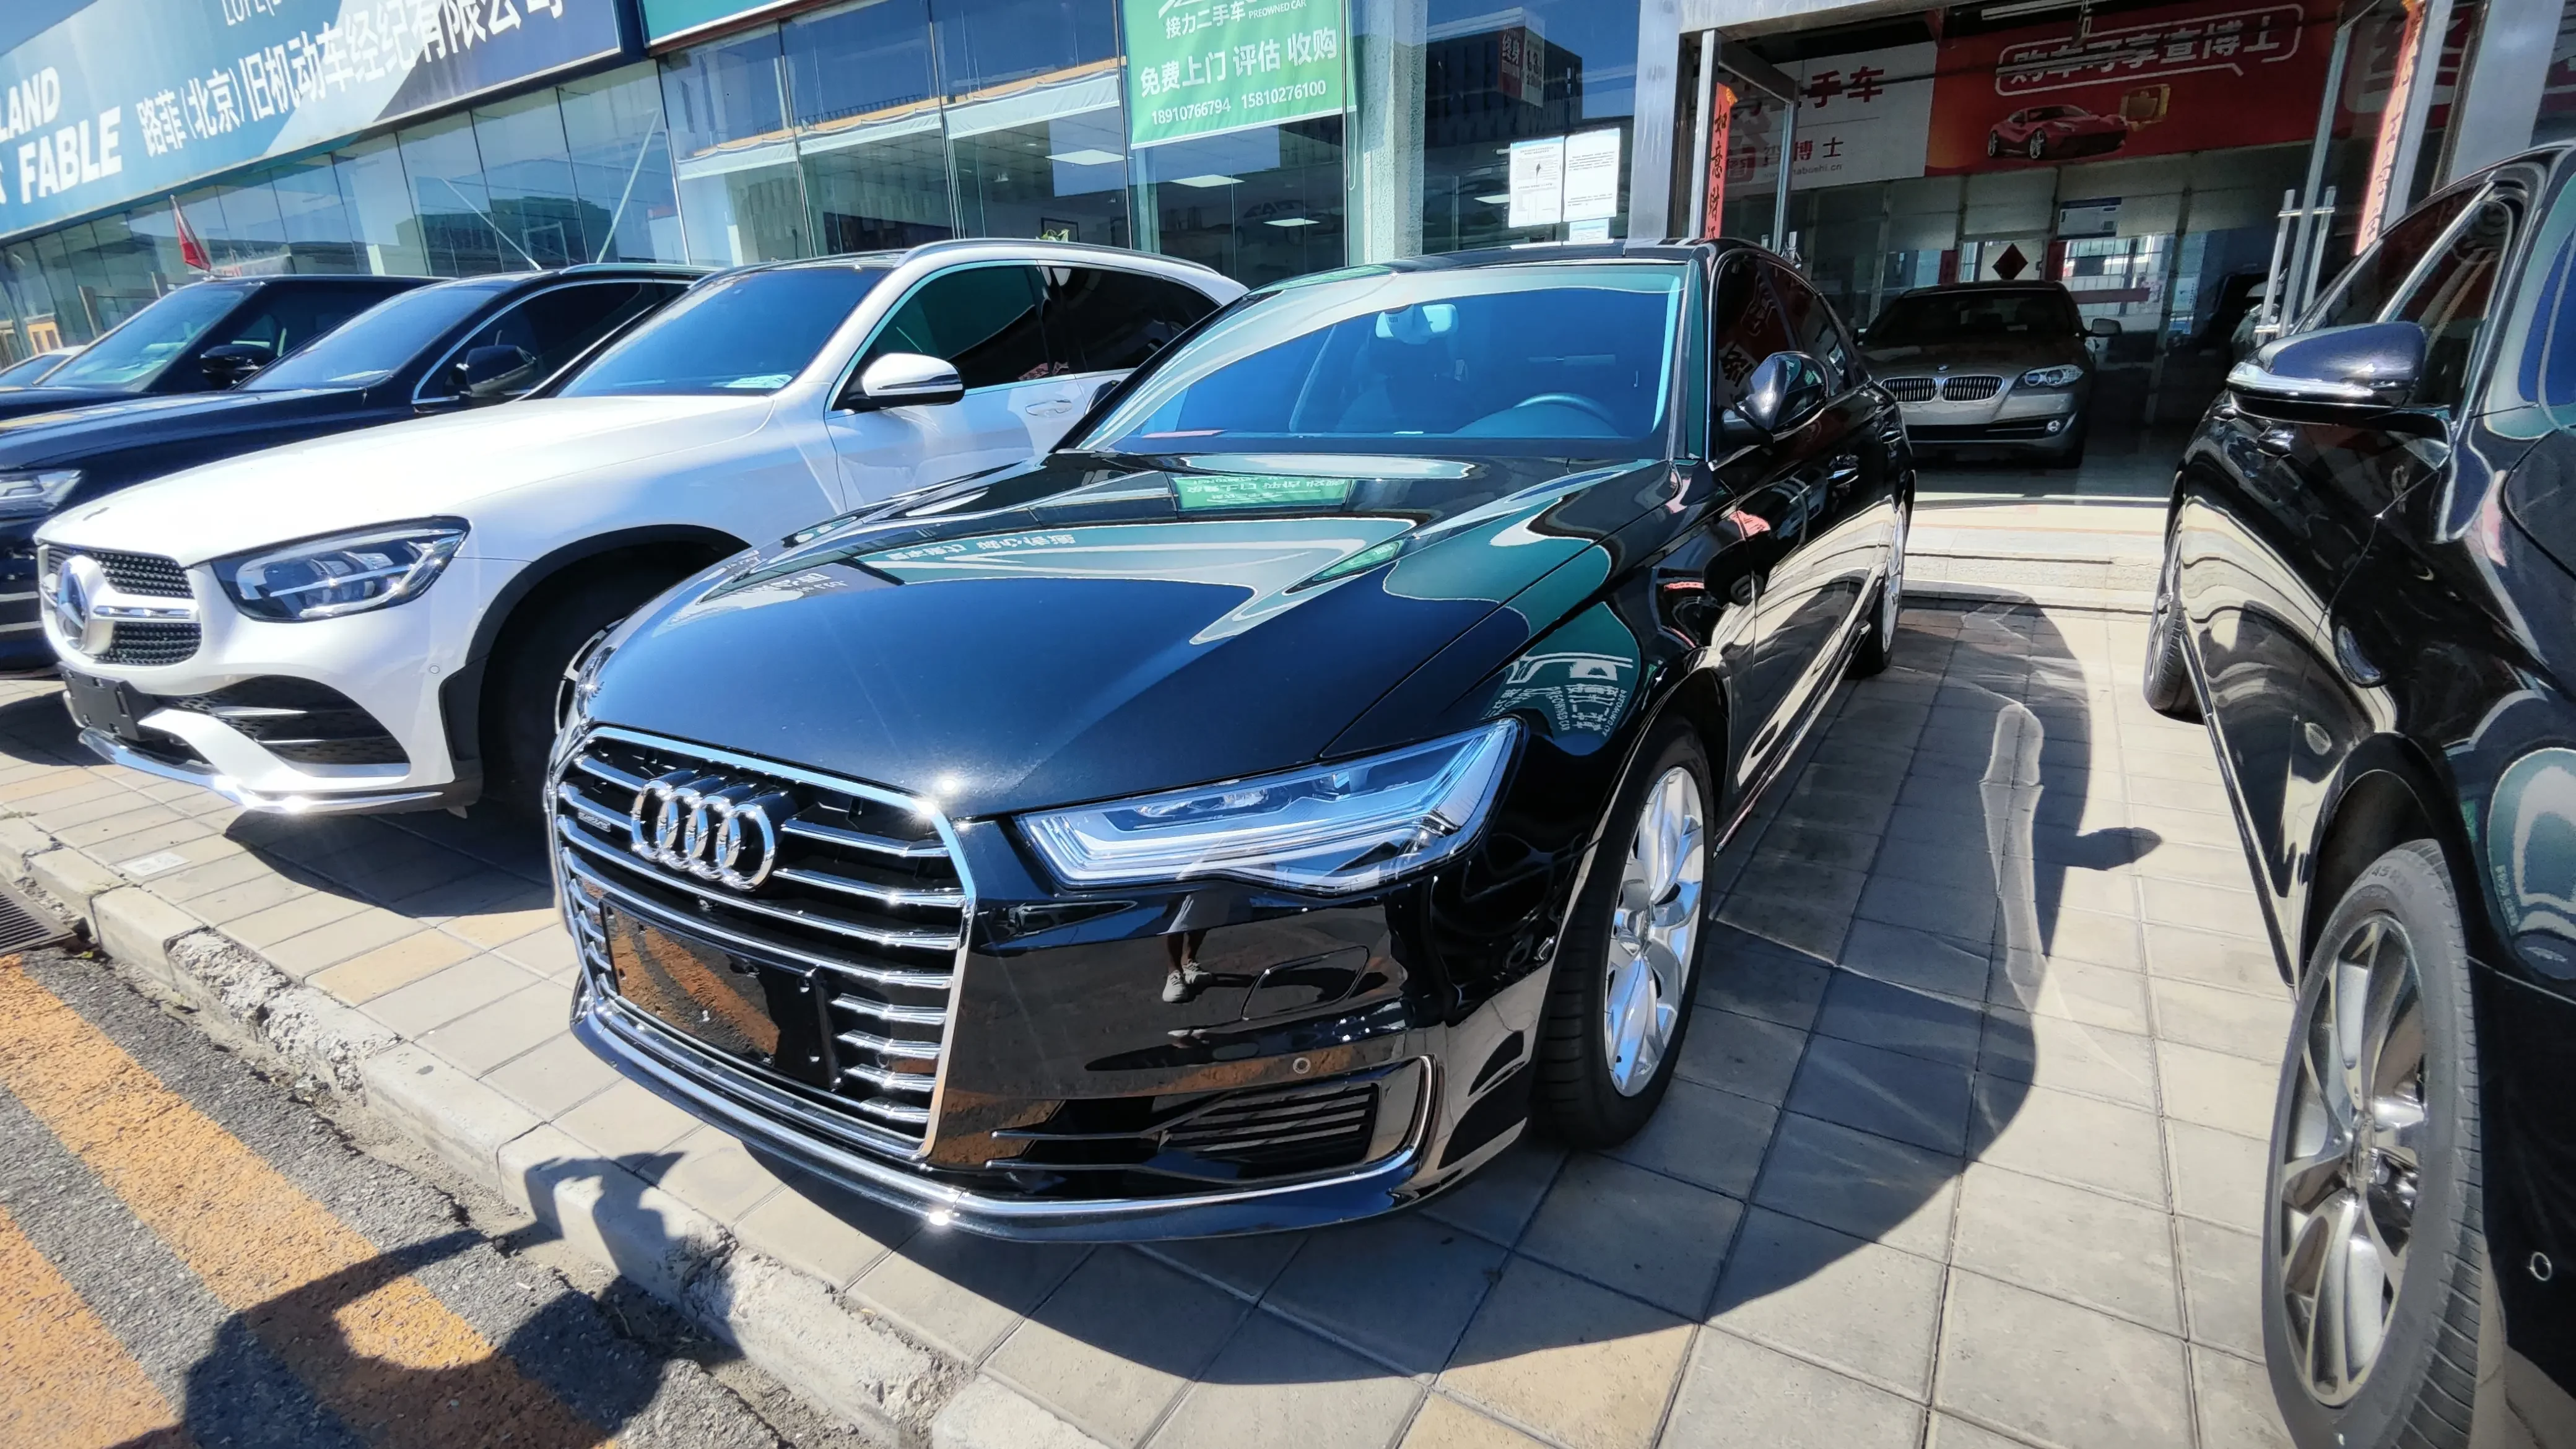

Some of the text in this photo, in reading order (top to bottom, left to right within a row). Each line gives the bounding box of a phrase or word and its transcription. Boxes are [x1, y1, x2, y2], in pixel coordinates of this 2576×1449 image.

[1165, 0, 1307, 39] 接力二手车 PREOWNED CAR
[1140, 27, 1338, 98] 免费上门 评估 收购
[1152, 80, 1326, 125] 18910766794 15810276100
[18, 105, 122, 204] FABLE
